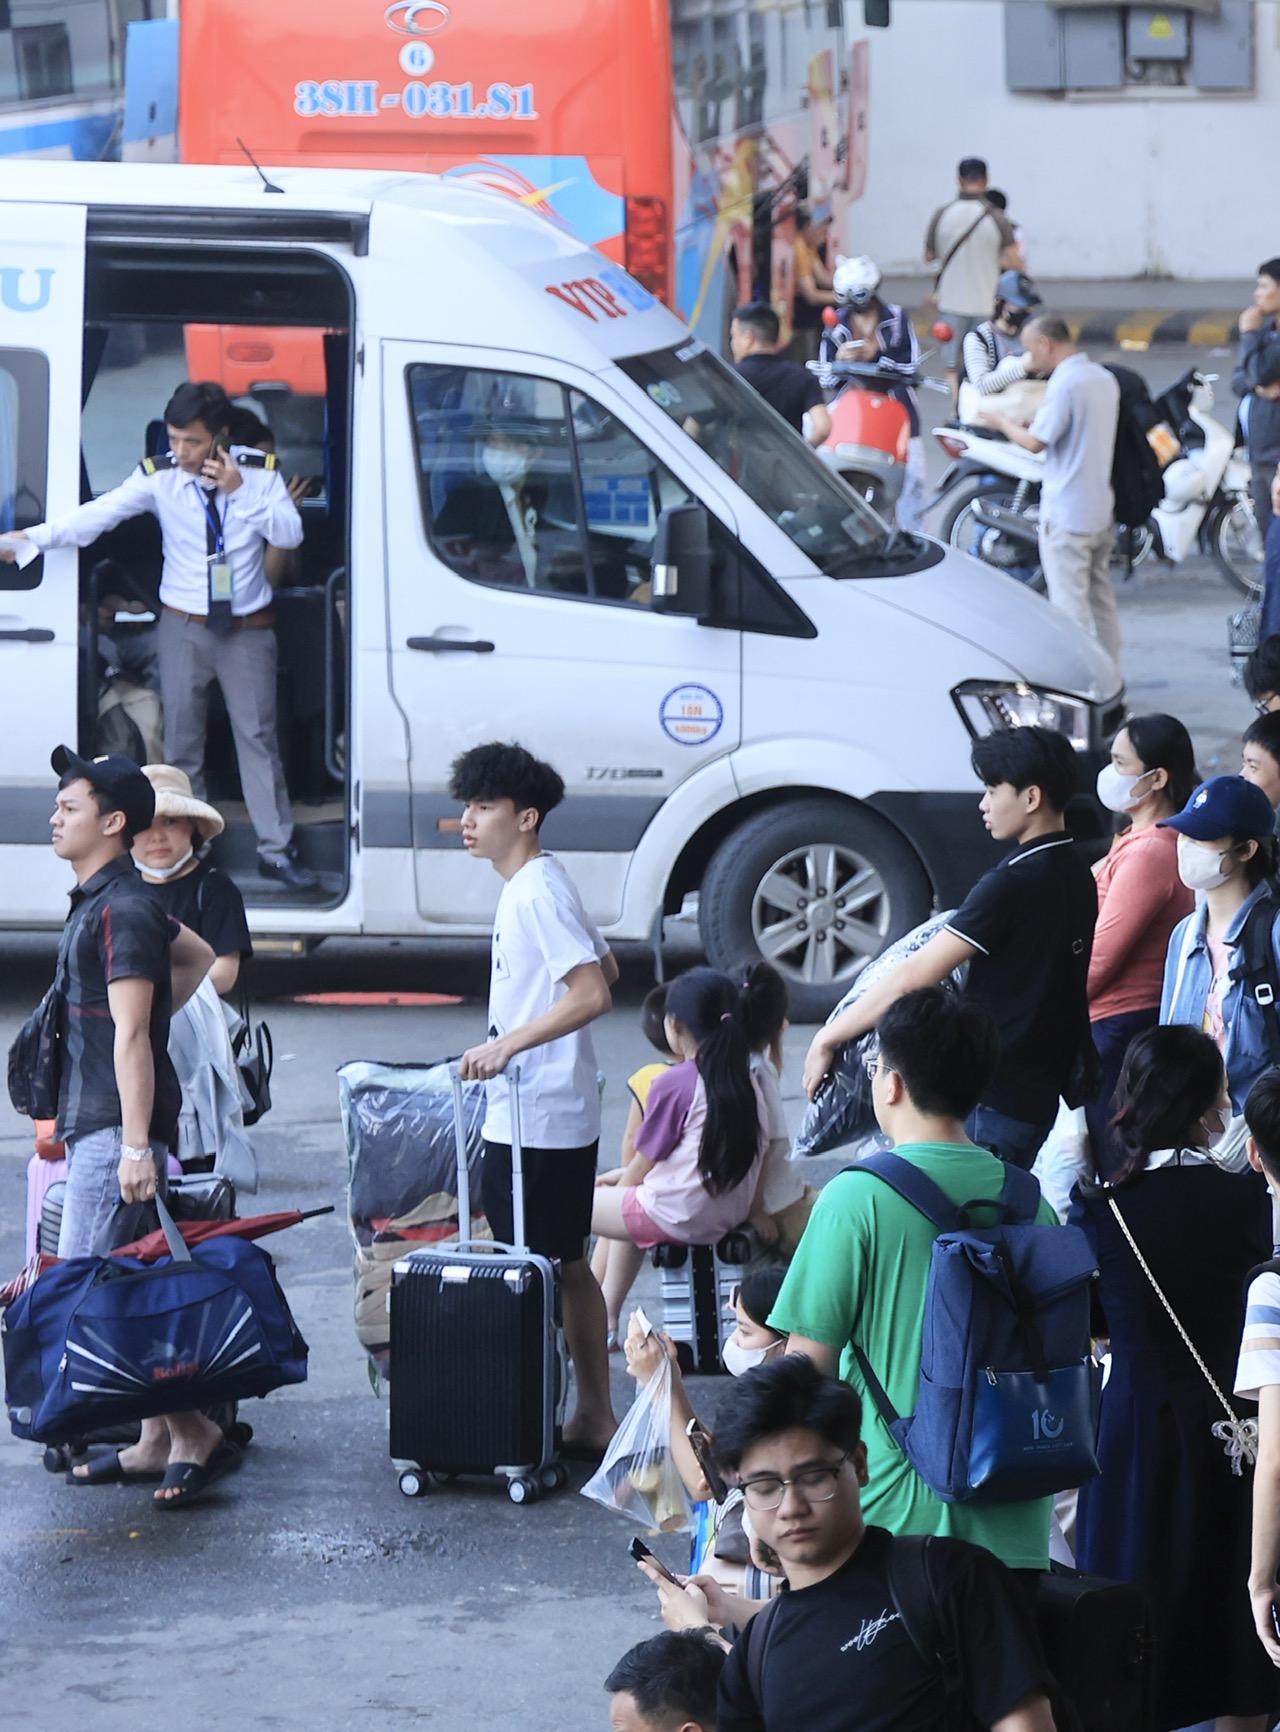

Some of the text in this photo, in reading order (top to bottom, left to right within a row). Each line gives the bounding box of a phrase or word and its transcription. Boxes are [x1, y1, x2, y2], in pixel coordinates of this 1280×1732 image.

[408, 48, 425, 67] 6
[0, 268, 56, 312] U
[545, 277, 628, 324] VIP
